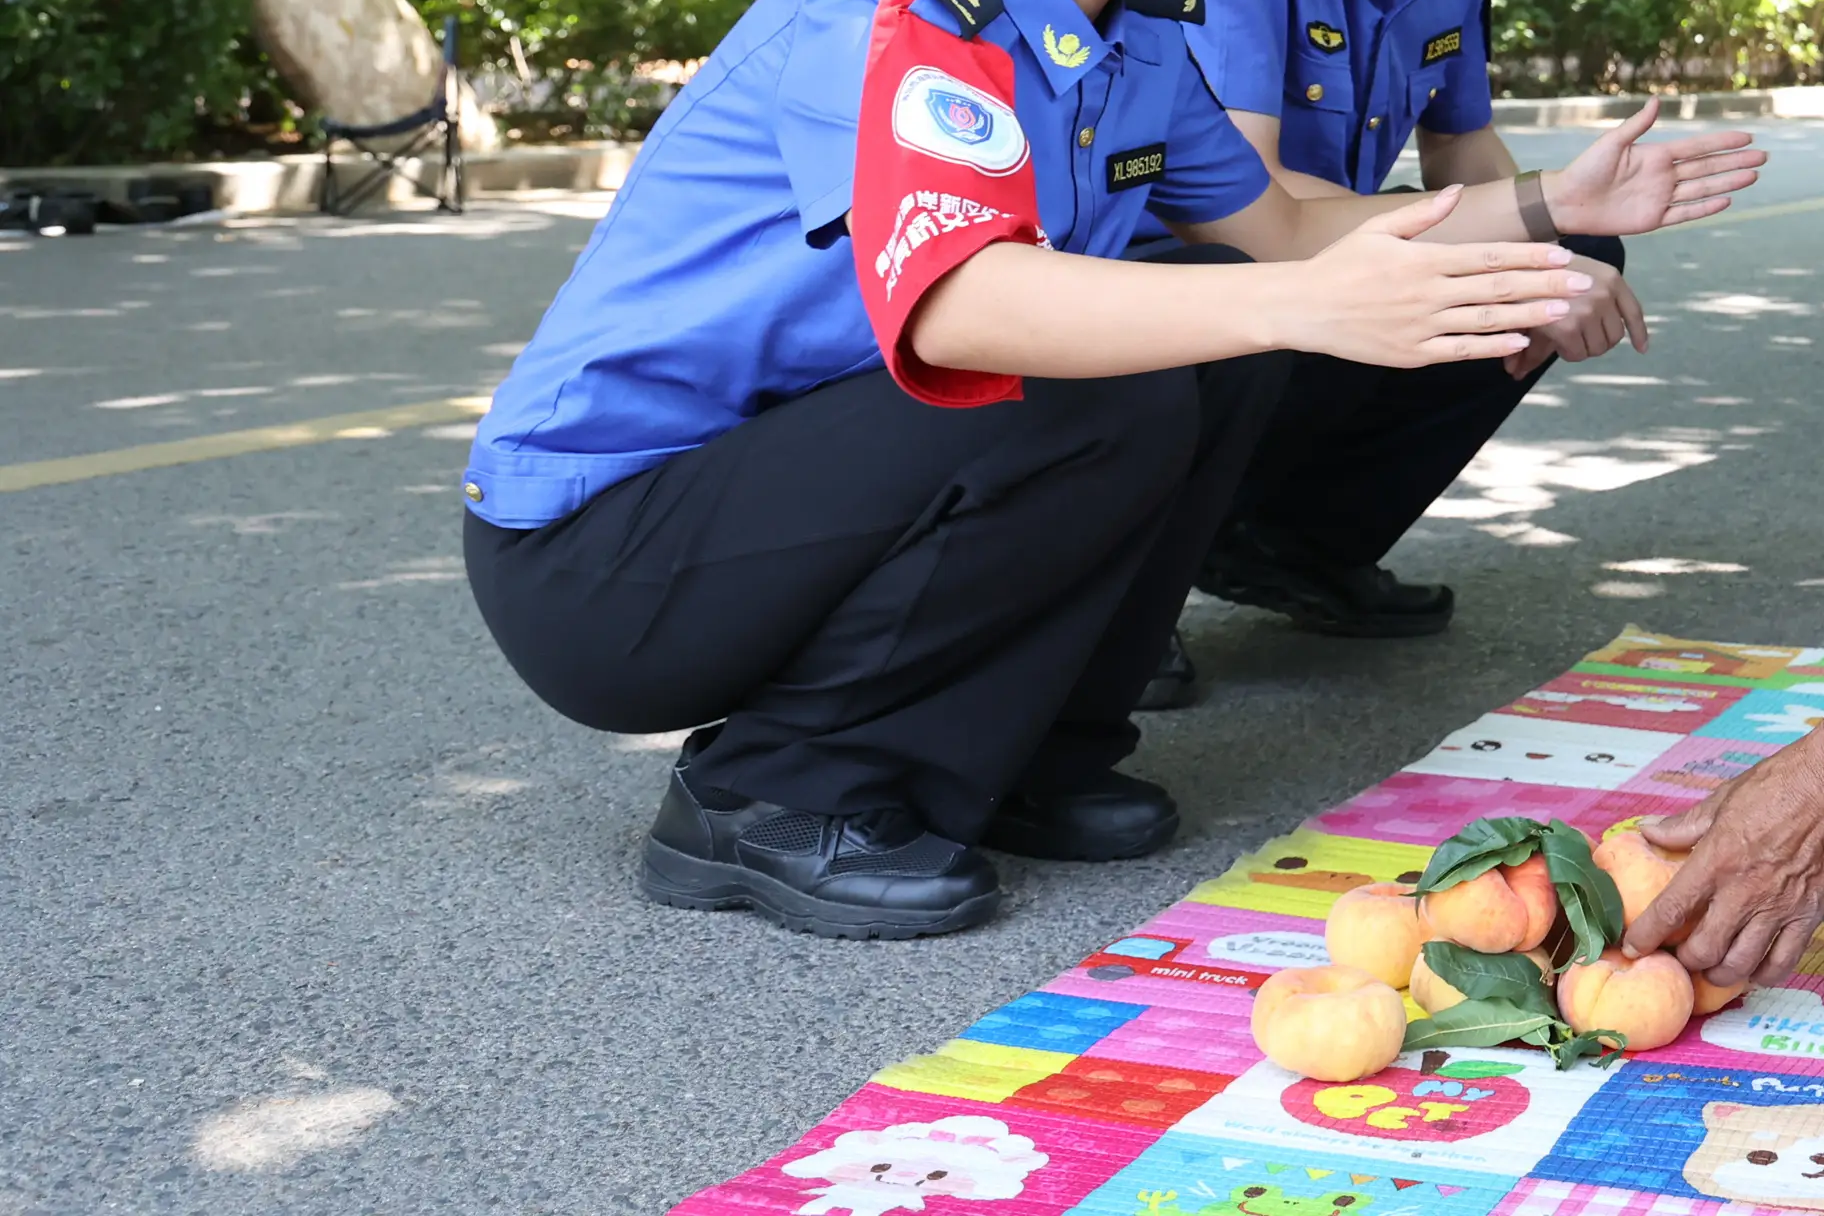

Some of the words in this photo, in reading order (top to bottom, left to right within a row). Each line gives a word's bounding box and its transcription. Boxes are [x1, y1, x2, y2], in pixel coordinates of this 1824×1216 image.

[1113, 152, 1162, 182] XL985192
[1150, 966, 1196, 979] mini
[1198, 971, 1249, 986] truck
